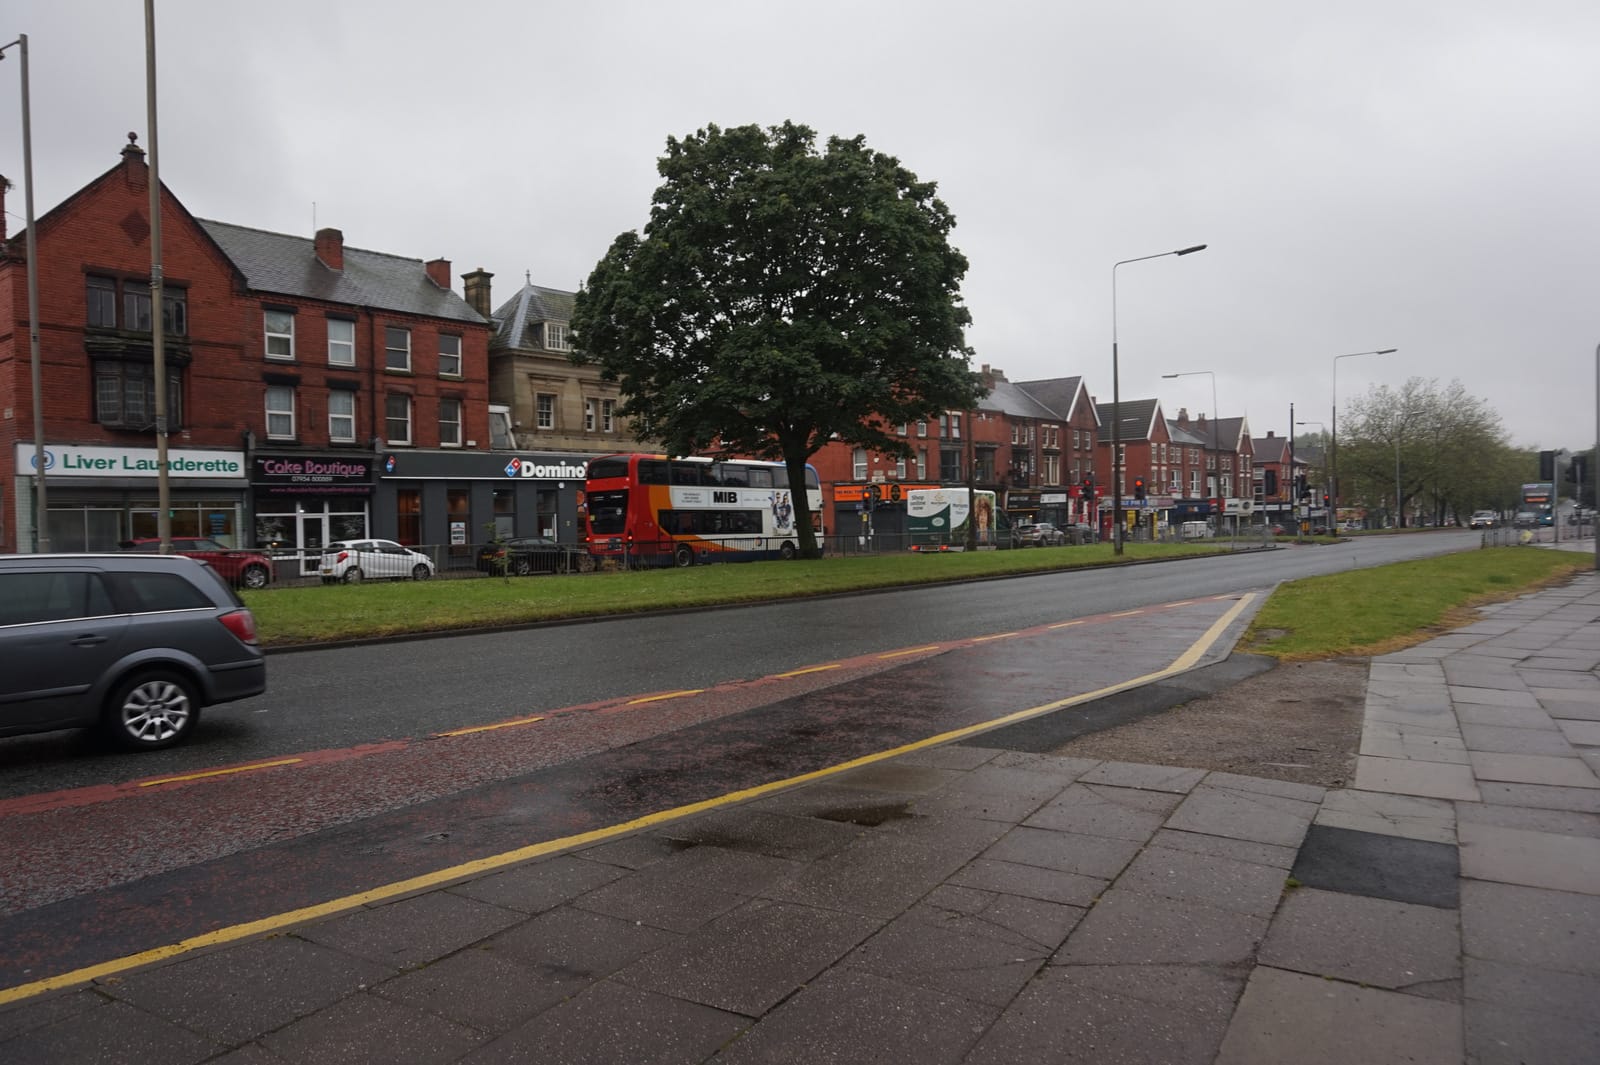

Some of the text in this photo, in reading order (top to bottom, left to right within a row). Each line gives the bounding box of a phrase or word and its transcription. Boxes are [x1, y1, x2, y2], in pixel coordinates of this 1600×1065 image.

[63, 453, 117, 470] Liver
[264, 460, 366, 477] Cake Boutique
[521, 460, 588, 478] Domino'
[713, 491, 738, 503] MIB
